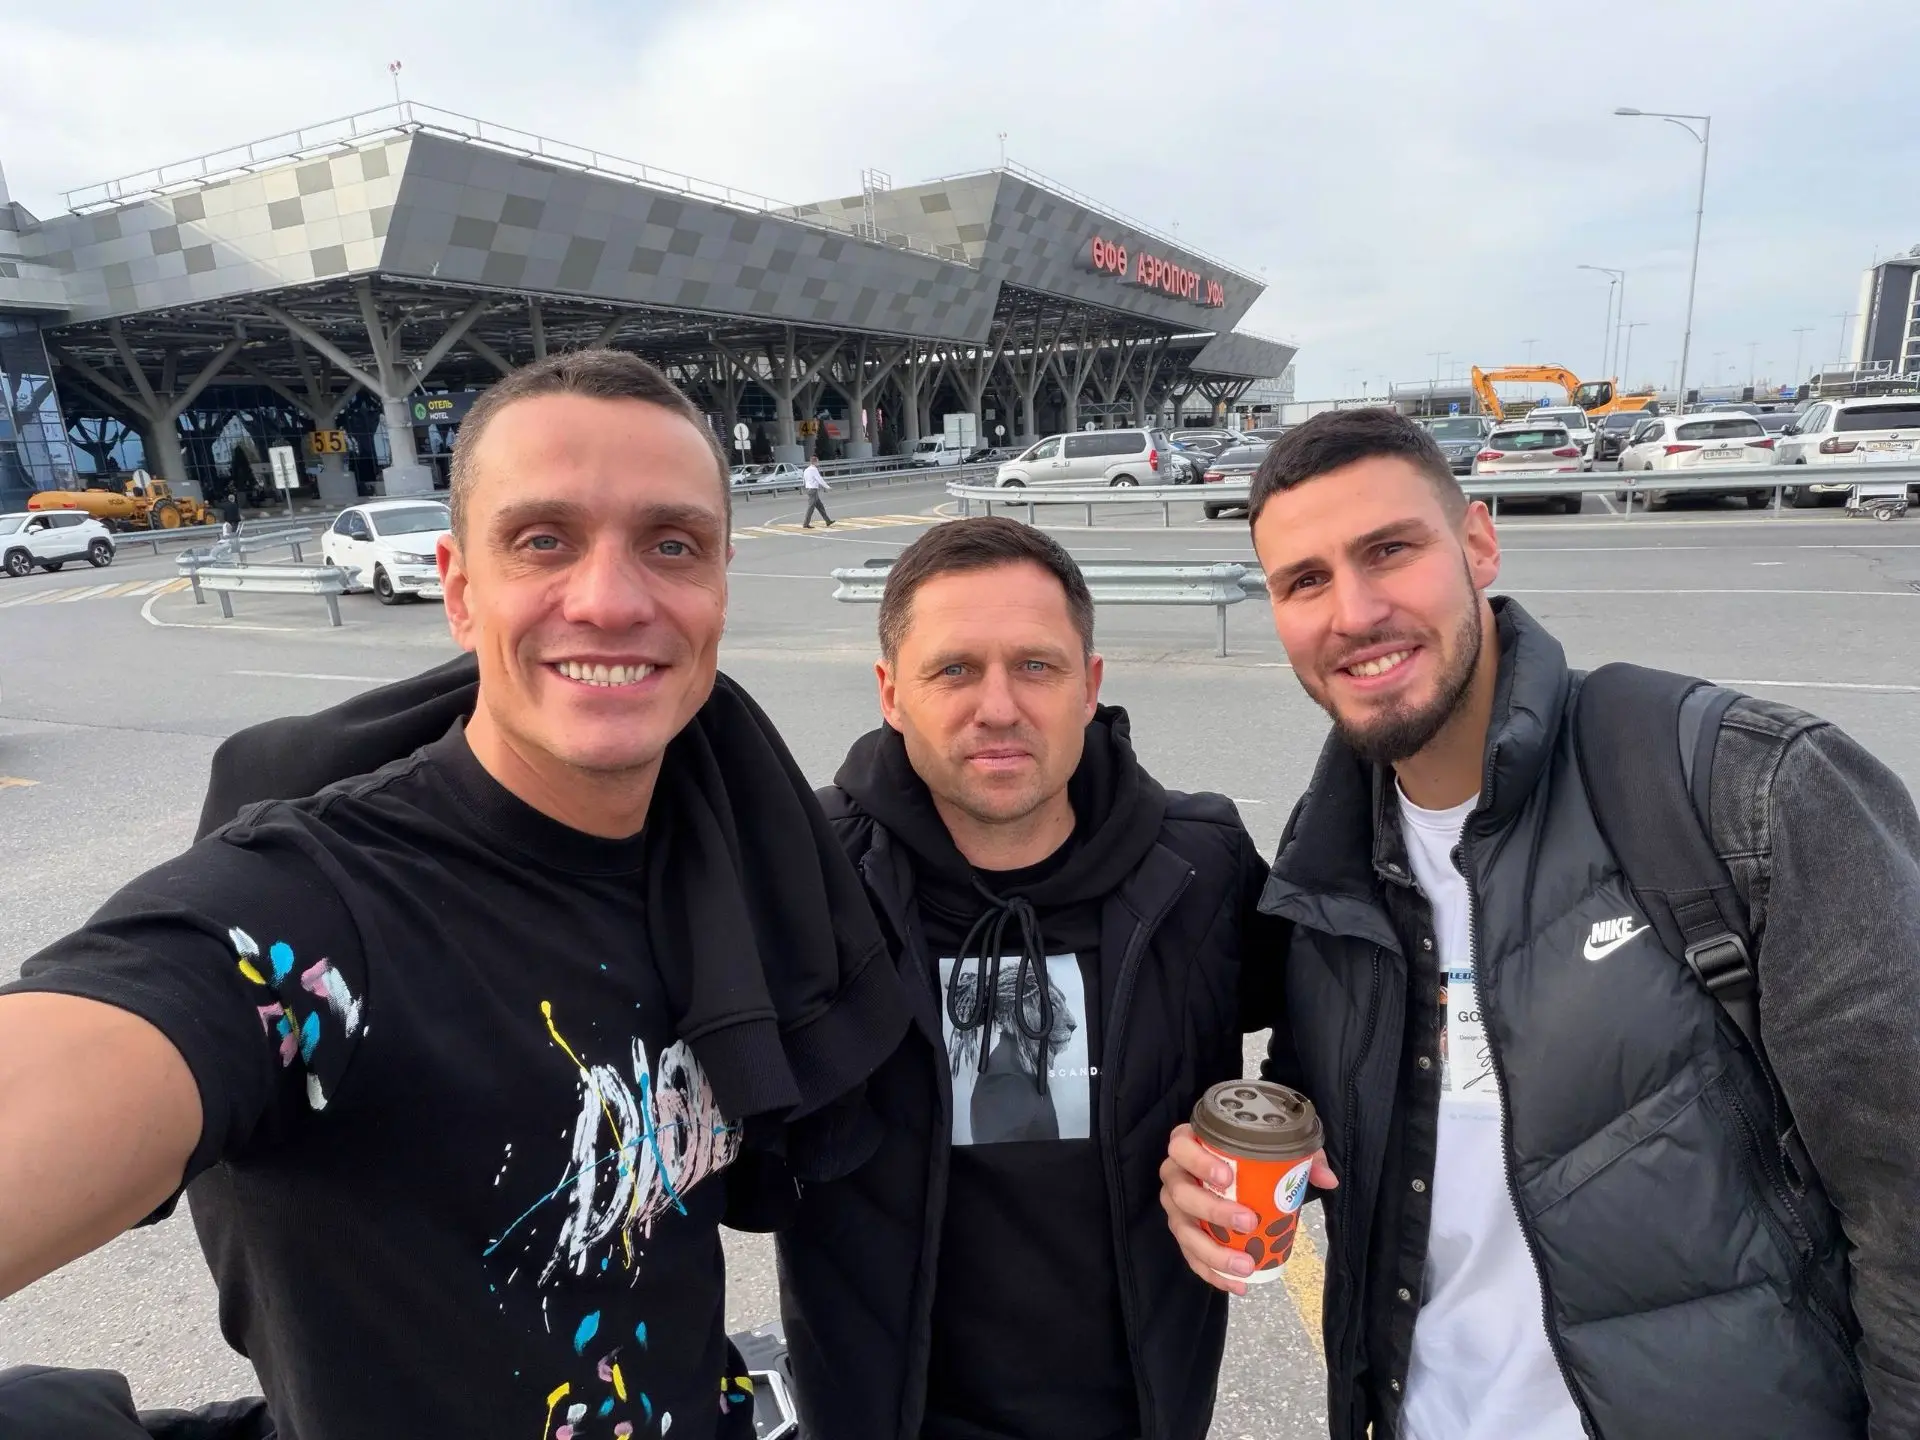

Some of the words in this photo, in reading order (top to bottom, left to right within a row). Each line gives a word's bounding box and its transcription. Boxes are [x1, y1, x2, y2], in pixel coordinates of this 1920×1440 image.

[1136, 251, 1201, 301] АЭРОПОРТ
[1207, 279, 1225, 308] УФА
[428, 400, 453, 410] ОТЕЛЬ
[429, 411, 449, 420] HOTEL
[1591, 916, 1632, 943] NIKE
